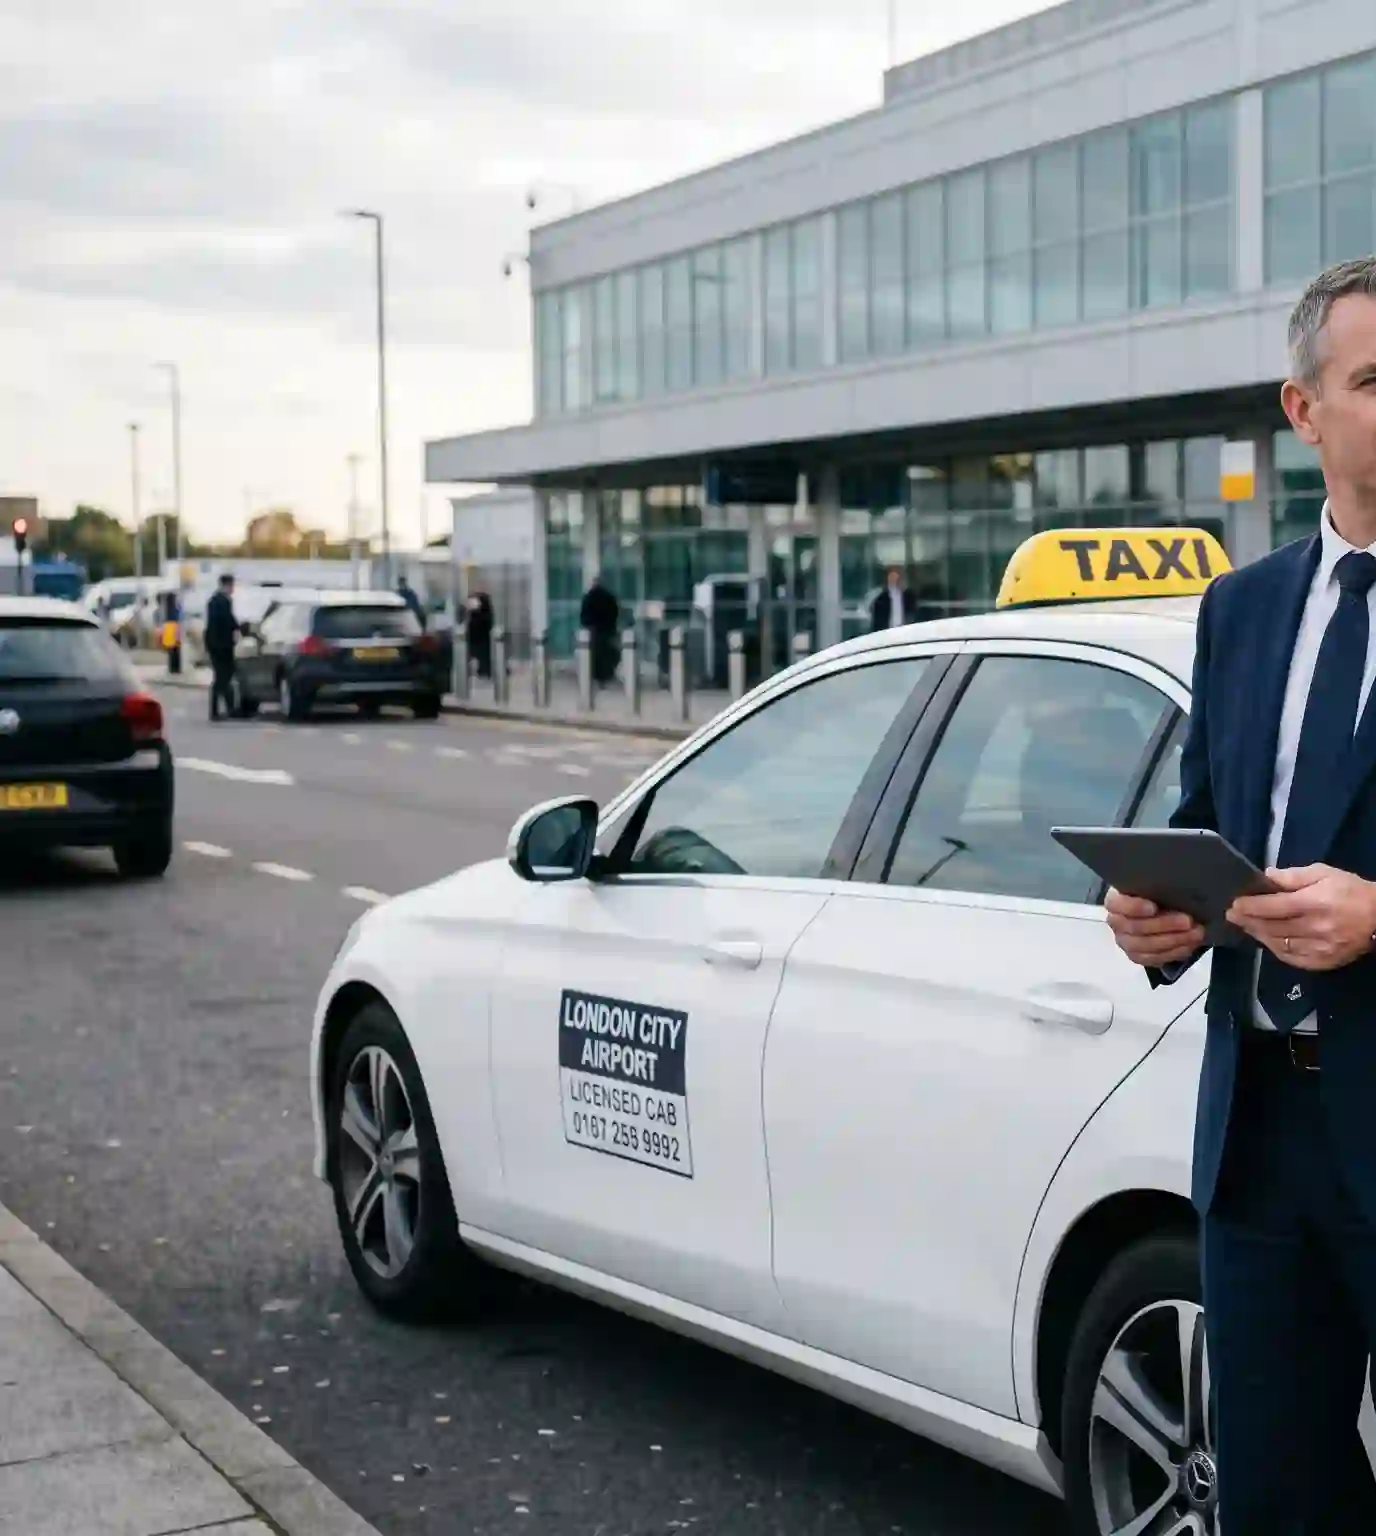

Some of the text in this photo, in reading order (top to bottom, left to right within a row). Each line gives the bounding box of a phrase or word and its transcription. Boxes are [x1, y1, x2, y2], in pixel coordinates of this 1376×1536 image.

[1058, 538, 1213, 581] TAXI
[563, 998, 682, 1050] LONDON CITY
[580, 1037, 658, 1082] AIRPORT
[569, 1077, 677, 1126] LICENSED CAB
[642, 1128, 681, 1161] 9992
